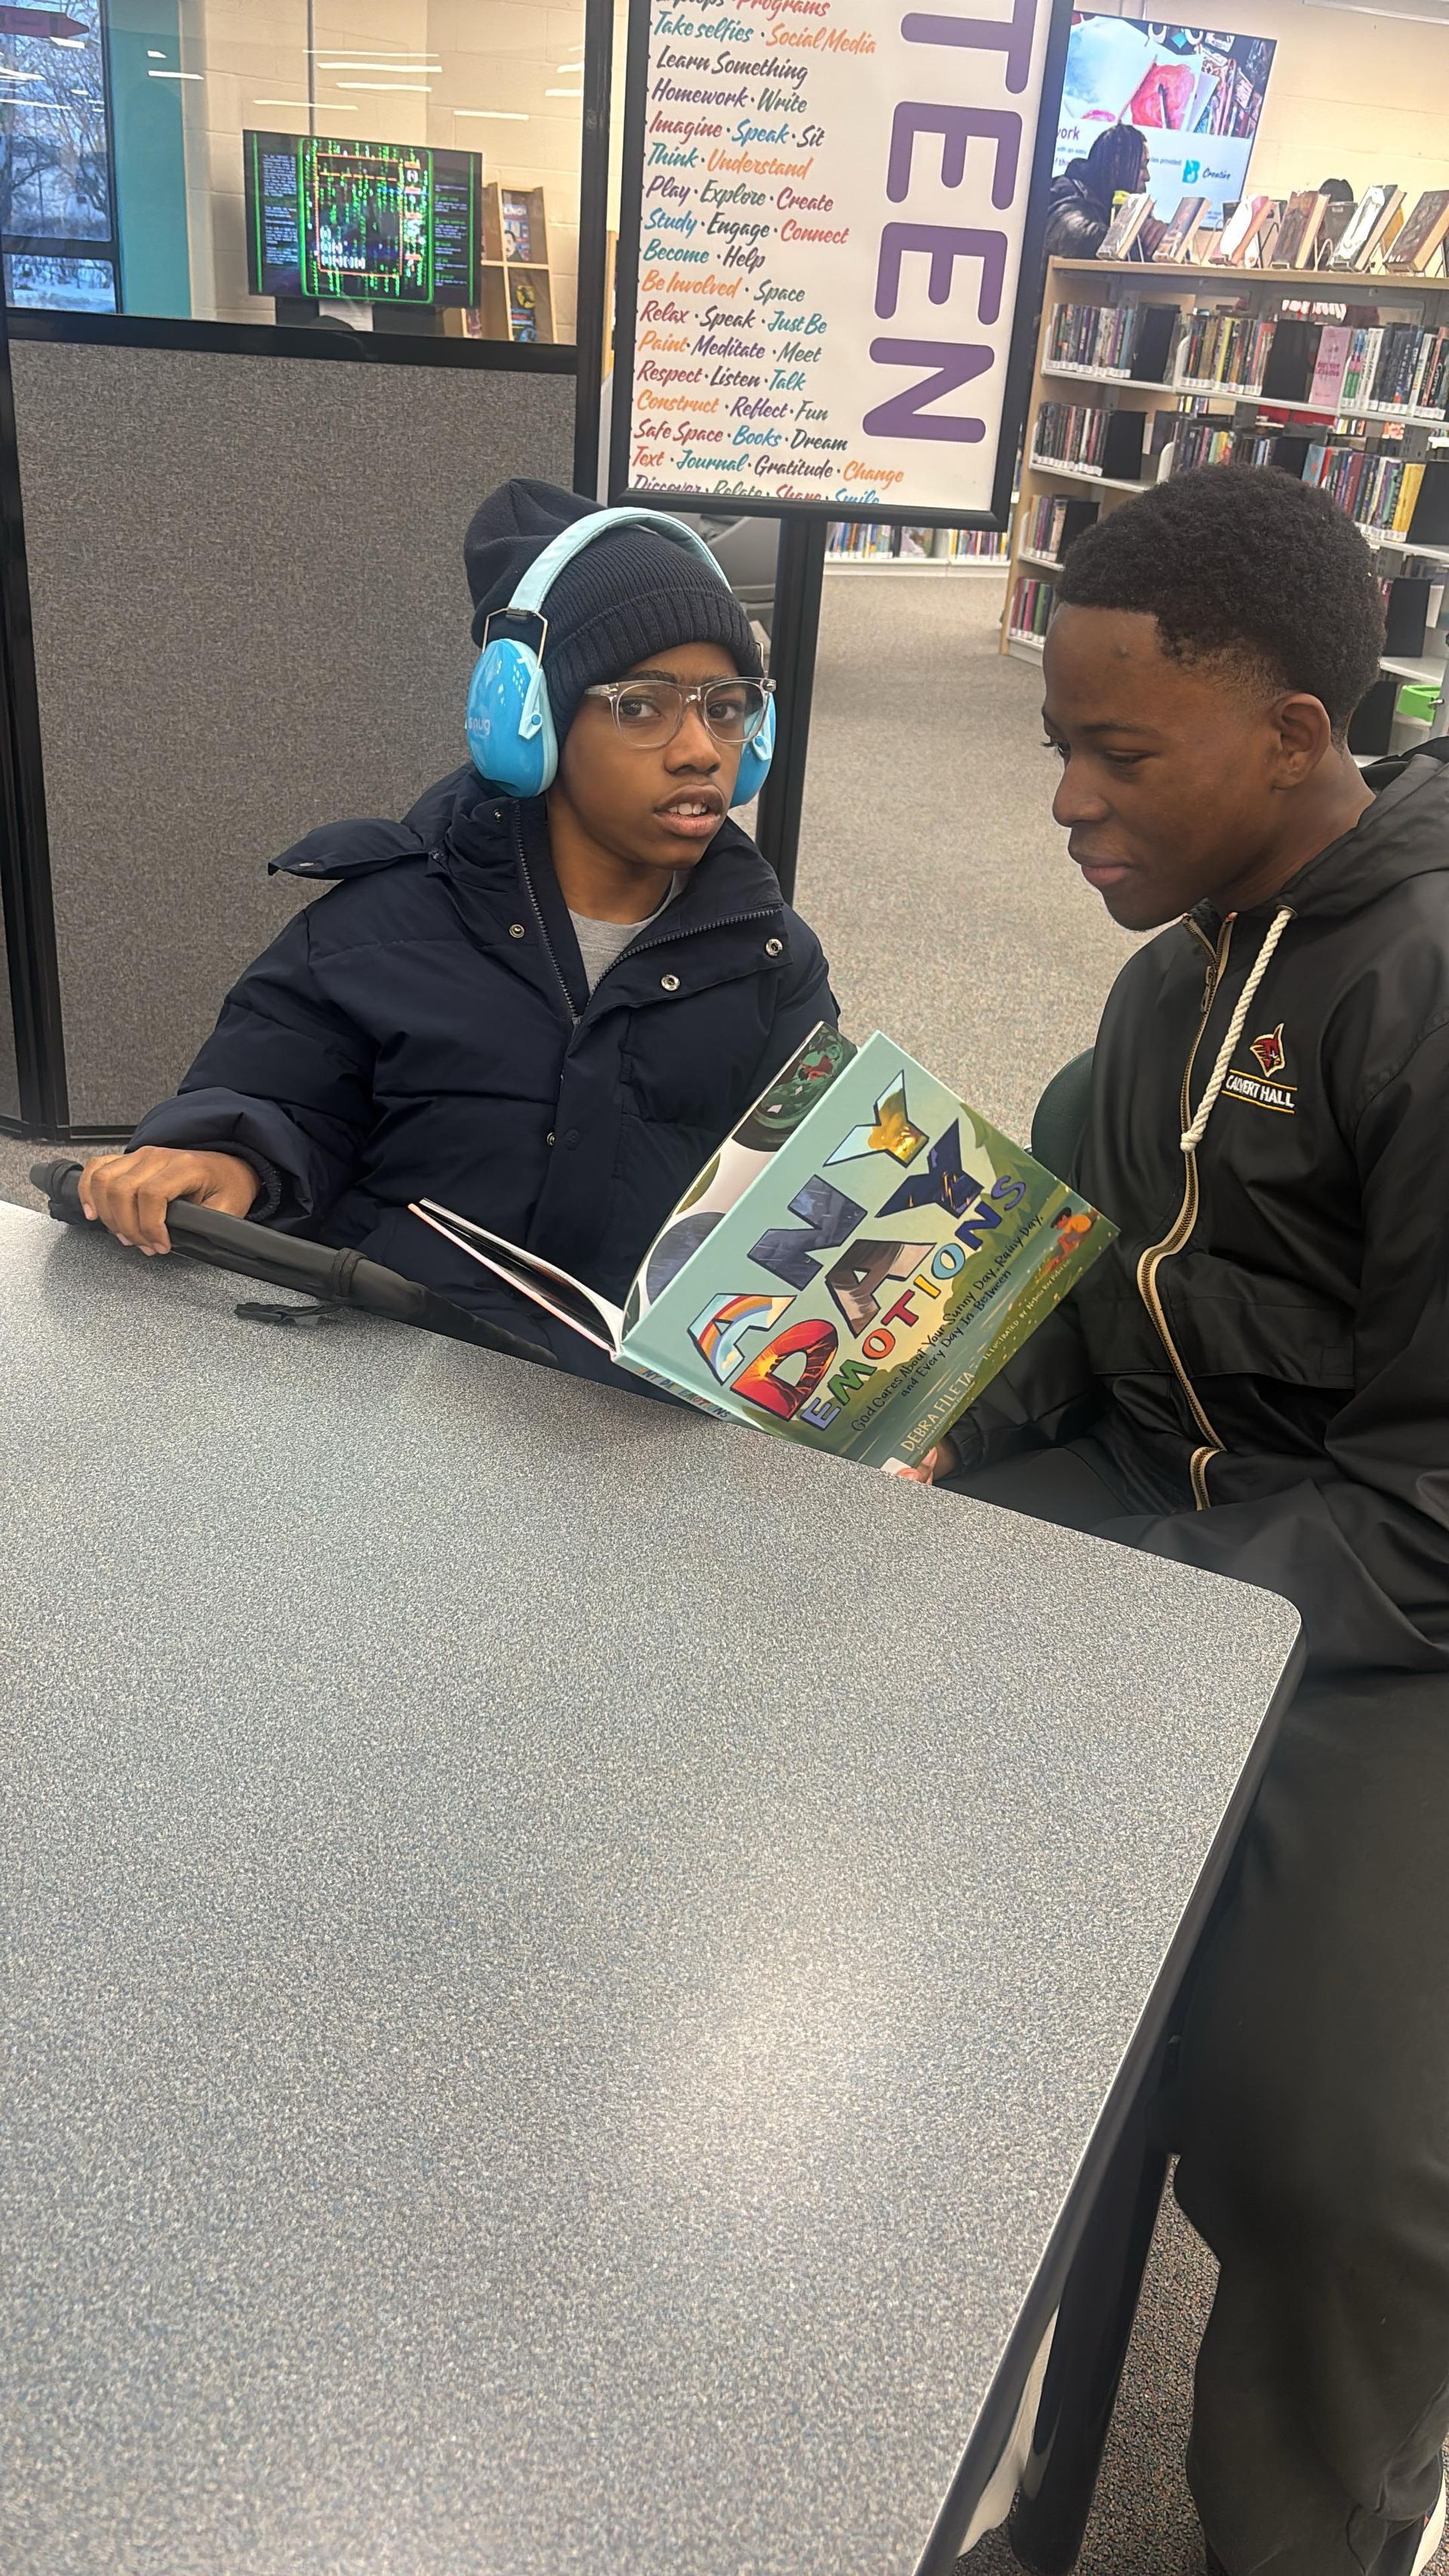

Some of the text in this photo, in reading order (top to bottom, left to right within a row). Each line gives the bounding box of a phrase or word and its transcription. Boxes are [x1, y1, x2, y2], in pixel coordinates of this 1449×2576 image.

[654, 10, 877, 55] Take selfies Social Media
[657, 45, 808, 90] Learn Something
[651, 78, 807, 113] Homework Write
[648, 110, 825, 148] Imagine Speak Sit
[647, 141, 814, 180] Think Understand
[645, 175, 833, 212] Play Explore Create
[644, 207, 849, 245] Study Engage Connect
[863, 0, 1038, 443] TEEN
[642, 238, 765, 274] Become Help
[641, 269, 805, 306] Be Involved Space
[640, 299, 827, 334] Relax Speak Just Be
[638, 330, 821, 363] Paint Meditate Meet
[636, 359, 805, 391] Respect Listen Talk
[636, 389, 829, 422] Construct Reflect Fun
[634, 417, 848, 452] Safe Space Books Dream
[631, 445, 904, 489] Text Journal Gratitude Change
[467, 717, 491, 736] snug
[1226, 1075, 1295, 1108] CALVERT HALL
[686, 1069, 930, 1386] ANY
[730, 1117, 985, 1422] DAY
[801, 1174, 1027, 1431] EMOTIONS
[851, 1406, 876, 1431] God
[872, 1376, 903, 1408] Cares
[899, 1348, 928, 1378] About
[921, 1325, 946, 1348] Your
[943, 1291, 977, 1325] Sunny
[995, 1238, 1024, 1270] Rainy
[901, 1270, 1012, 1397] and Every Day In Between
[900, 1371, 975, 1452] DEBRA FILETA
